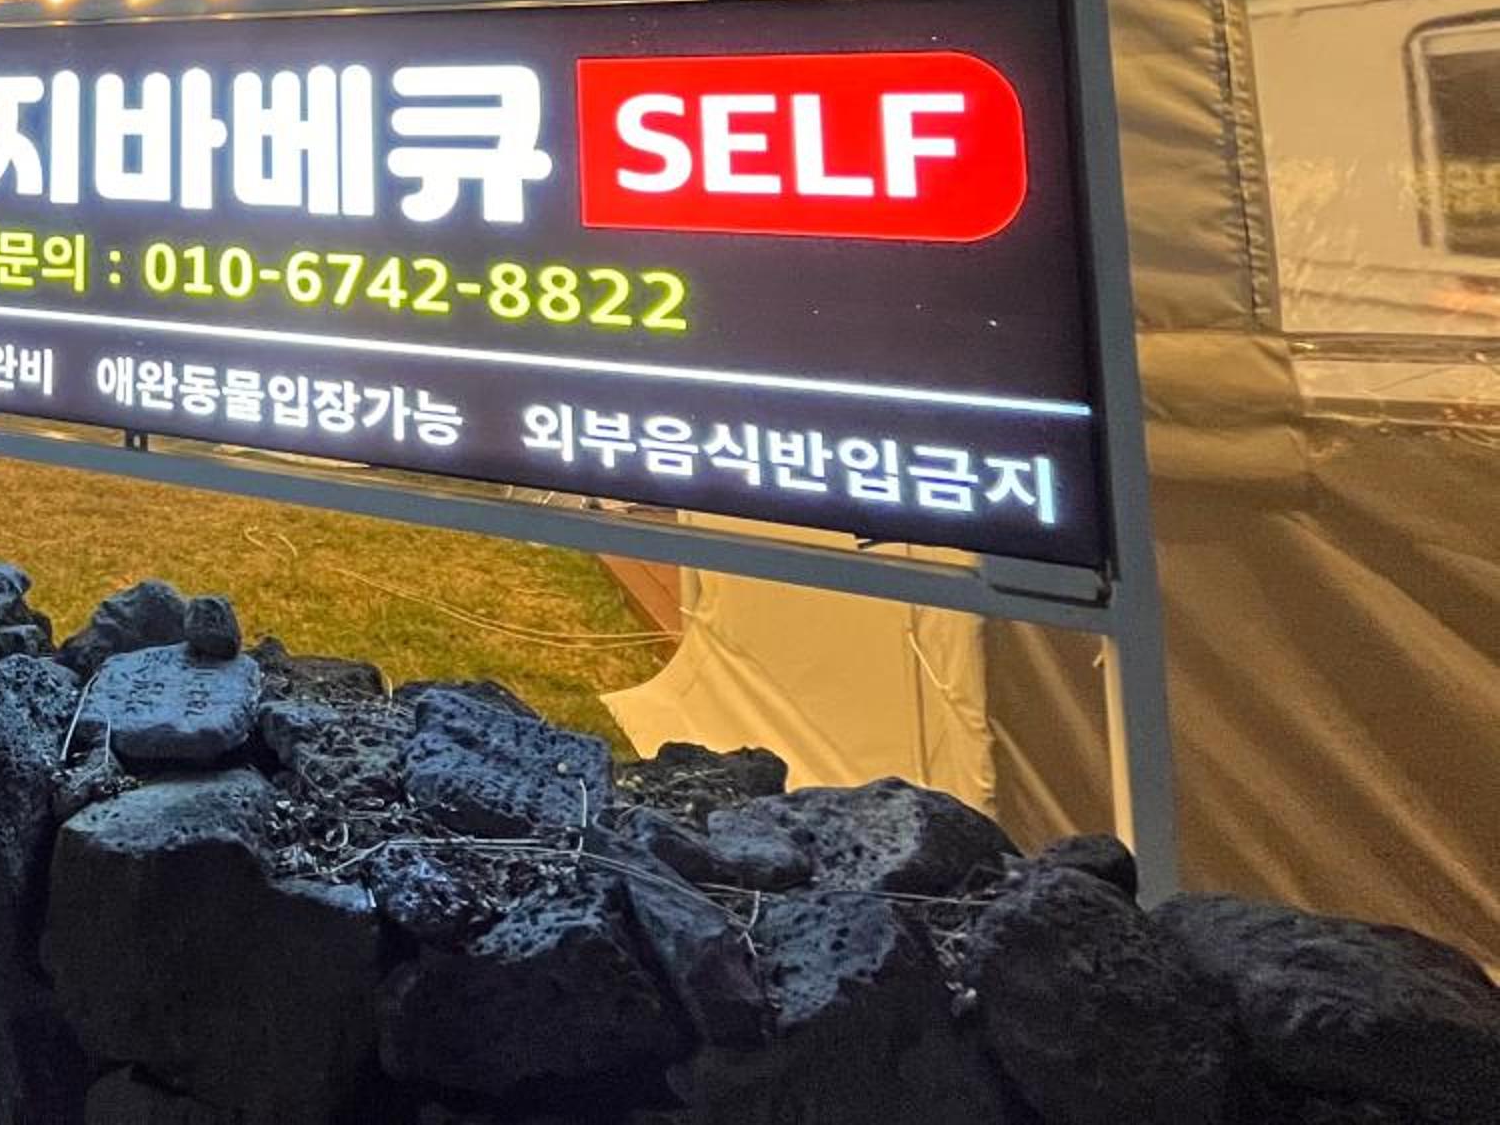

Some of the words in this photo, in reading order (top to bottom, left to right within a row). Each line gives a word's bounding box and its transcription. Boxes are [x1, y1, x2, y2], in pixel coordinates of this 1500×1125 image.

[615, 92, 966, 199] SELF
[143, 240, 688, 333] 010-6742-8822
[95, 355, 464, 448] 애완동물입장가능
[519, 402, 1057, 526] 외부음식반입금지
